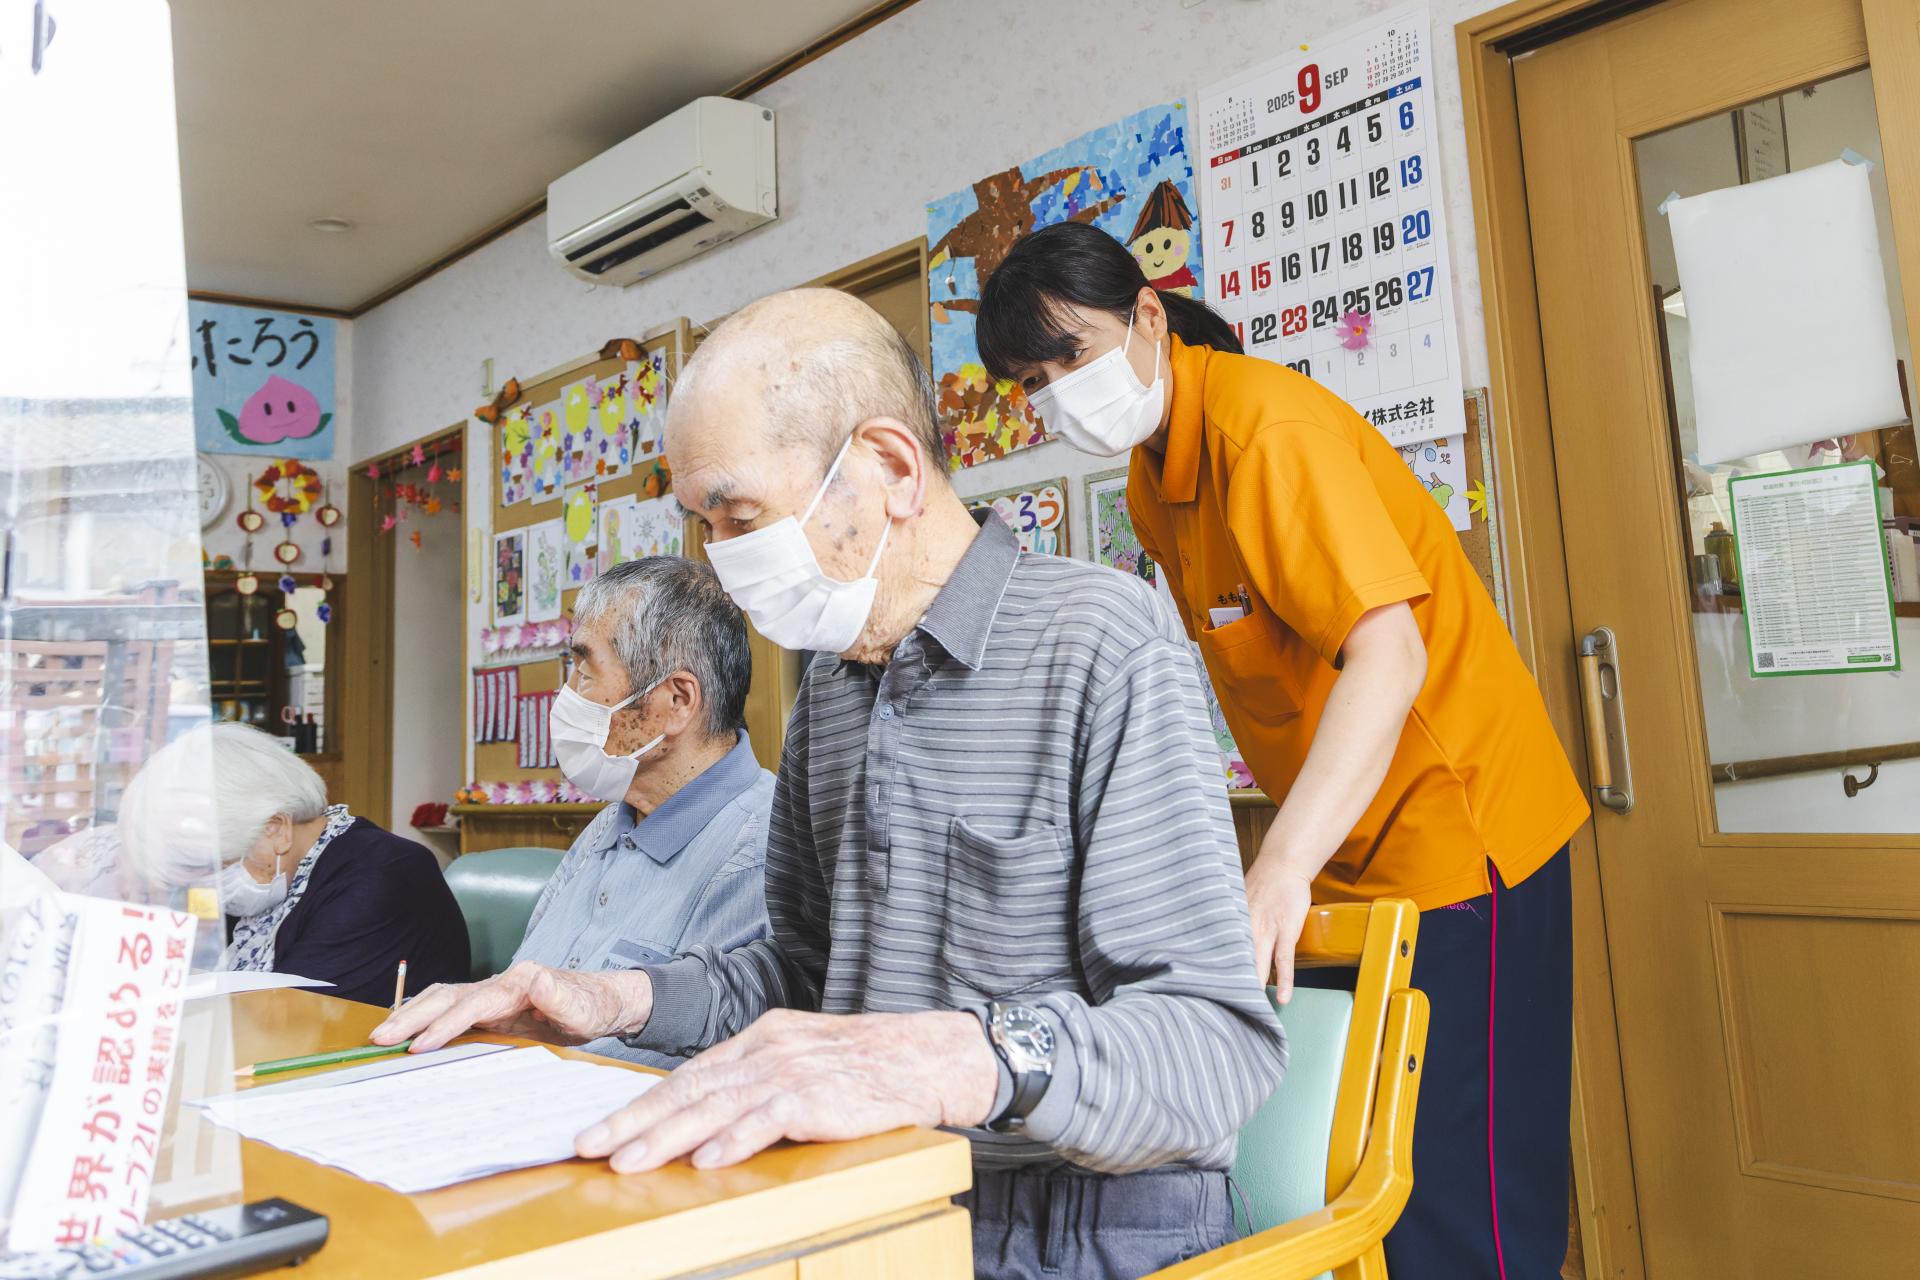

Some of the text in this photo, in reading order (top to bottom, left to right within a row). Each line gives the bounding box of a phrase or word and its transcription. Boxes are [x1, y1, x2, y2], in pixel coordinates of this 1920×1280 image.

[1267, 63, 1349, 114] 2025 9 SEP
[1275, 135, 1282, 144] 火
[1303, 124, 1310, 132] 水
[1396, 87, 1403, 95] 土
[1221, 101, 1414, 191] 31 1 2 3 4 5 6
[1221, 154, 1423, 247] 7 8 9 10 11 12 13
[1220, 210, 1431, 300] 14 15 16 17 18 19 20
[1228, 265, 1434, 348] 1 22 23 24 25 26 27
[191, 317, 319, 378] たろう
[1327, 361, 1330, 374] 1
[1357, 352, 1365, 366] 2
[1390, 343, 1397, 357] 3
[1423, 334, 1431, 348] 4
[1363, 396, 1435, 426] 株式会社
[993, 490, 1060, 532] ろう
